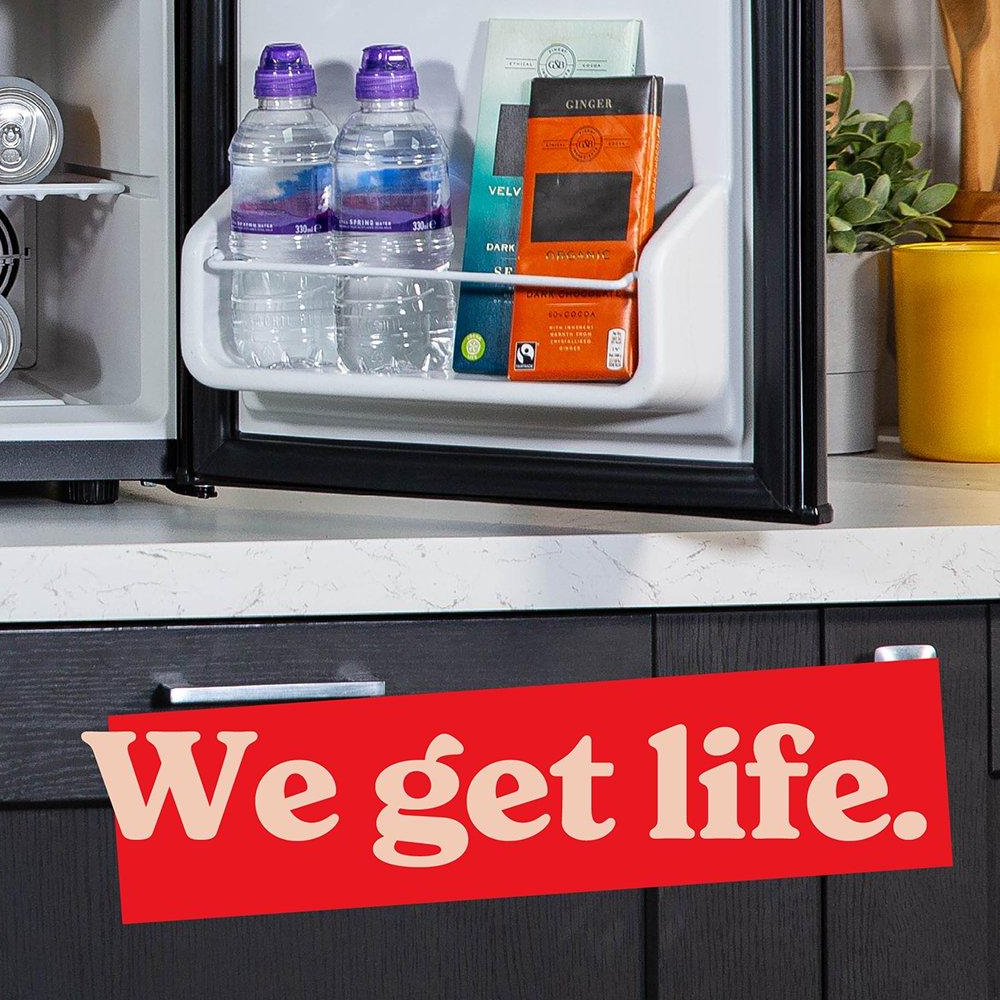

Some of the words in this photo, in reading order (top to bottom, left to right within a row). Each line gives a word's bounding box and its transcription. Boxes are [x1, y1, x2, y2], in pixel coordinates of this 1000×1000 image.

[565, 98, 613, 110] GINGER
[349, 218, 375, 226] SPRING
[486, 243, 516, 253] DARK
[545, 250, 610, 262] ORGANIC
[526, 289, 555, 299] DARK
